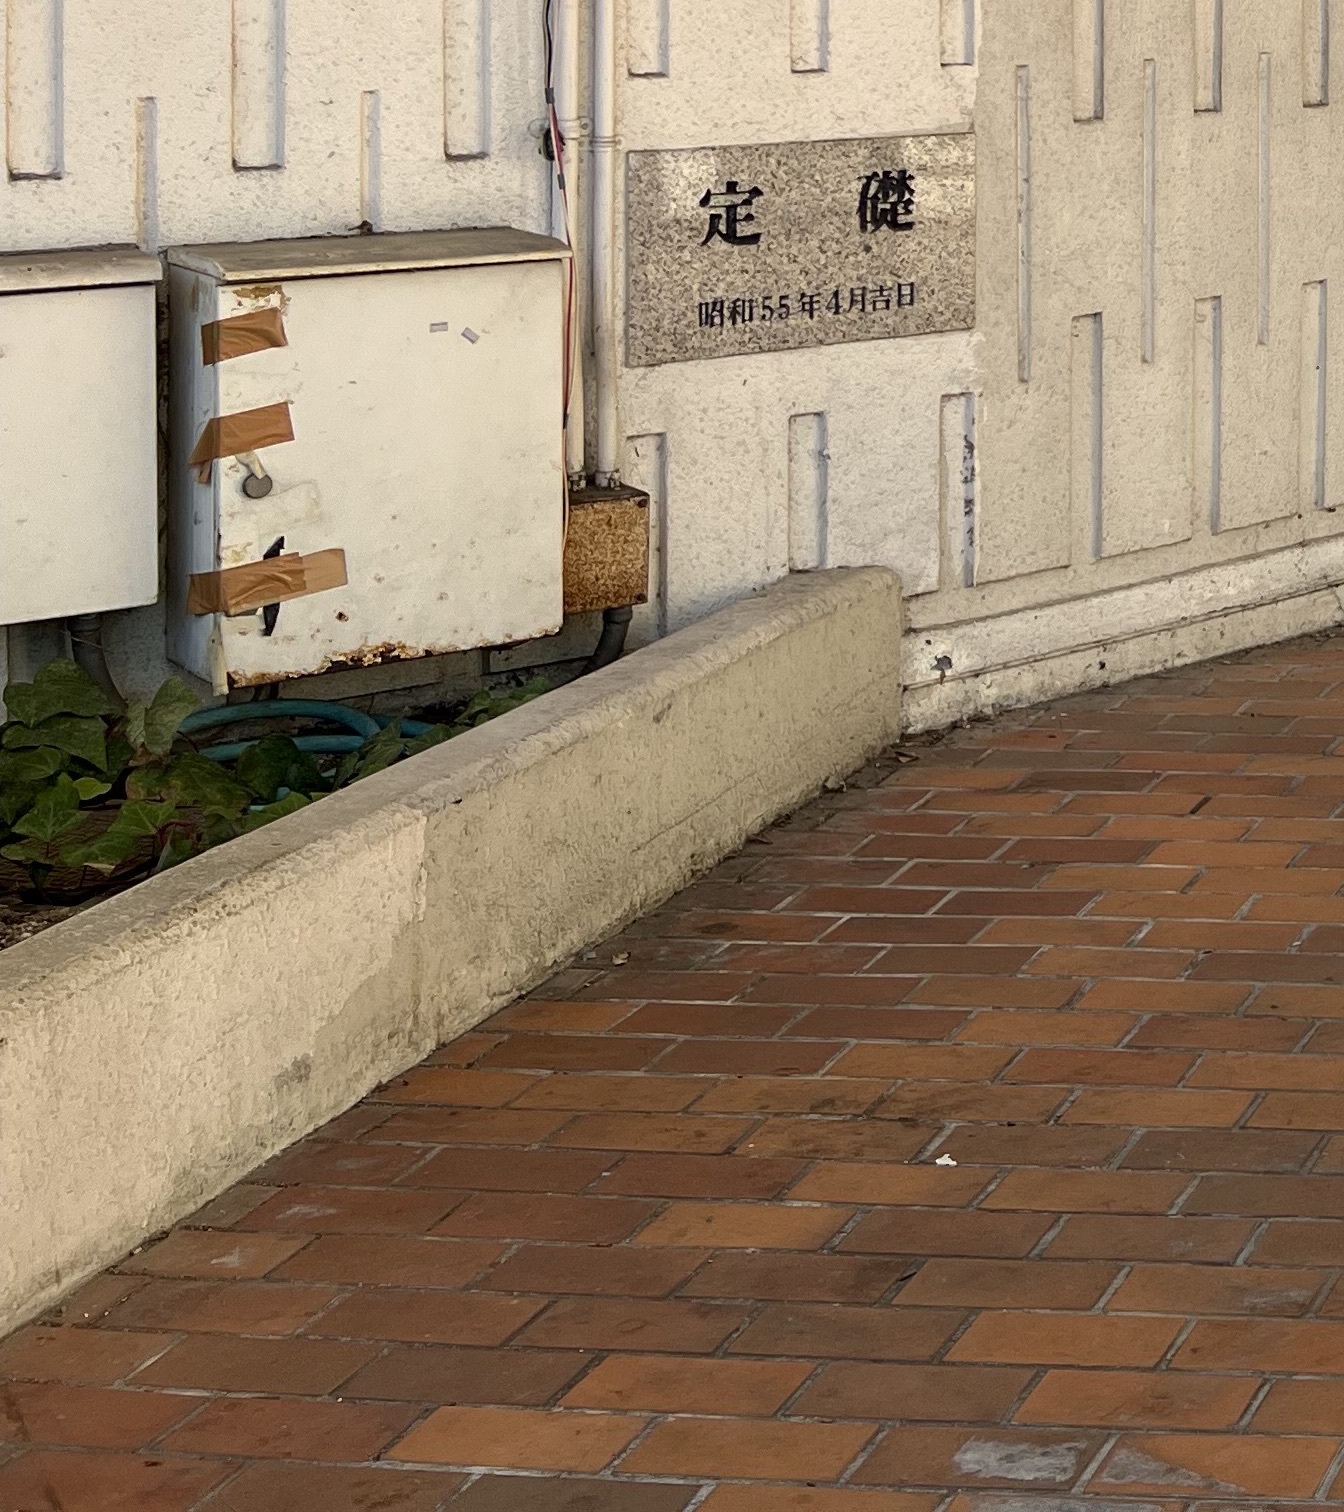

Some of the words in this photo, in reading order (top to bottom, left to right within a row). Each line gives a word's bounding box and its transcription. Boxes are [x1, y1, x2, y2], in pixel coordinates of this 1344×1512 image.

[698, 282, 915, 329] 昭和55年4月吉日
